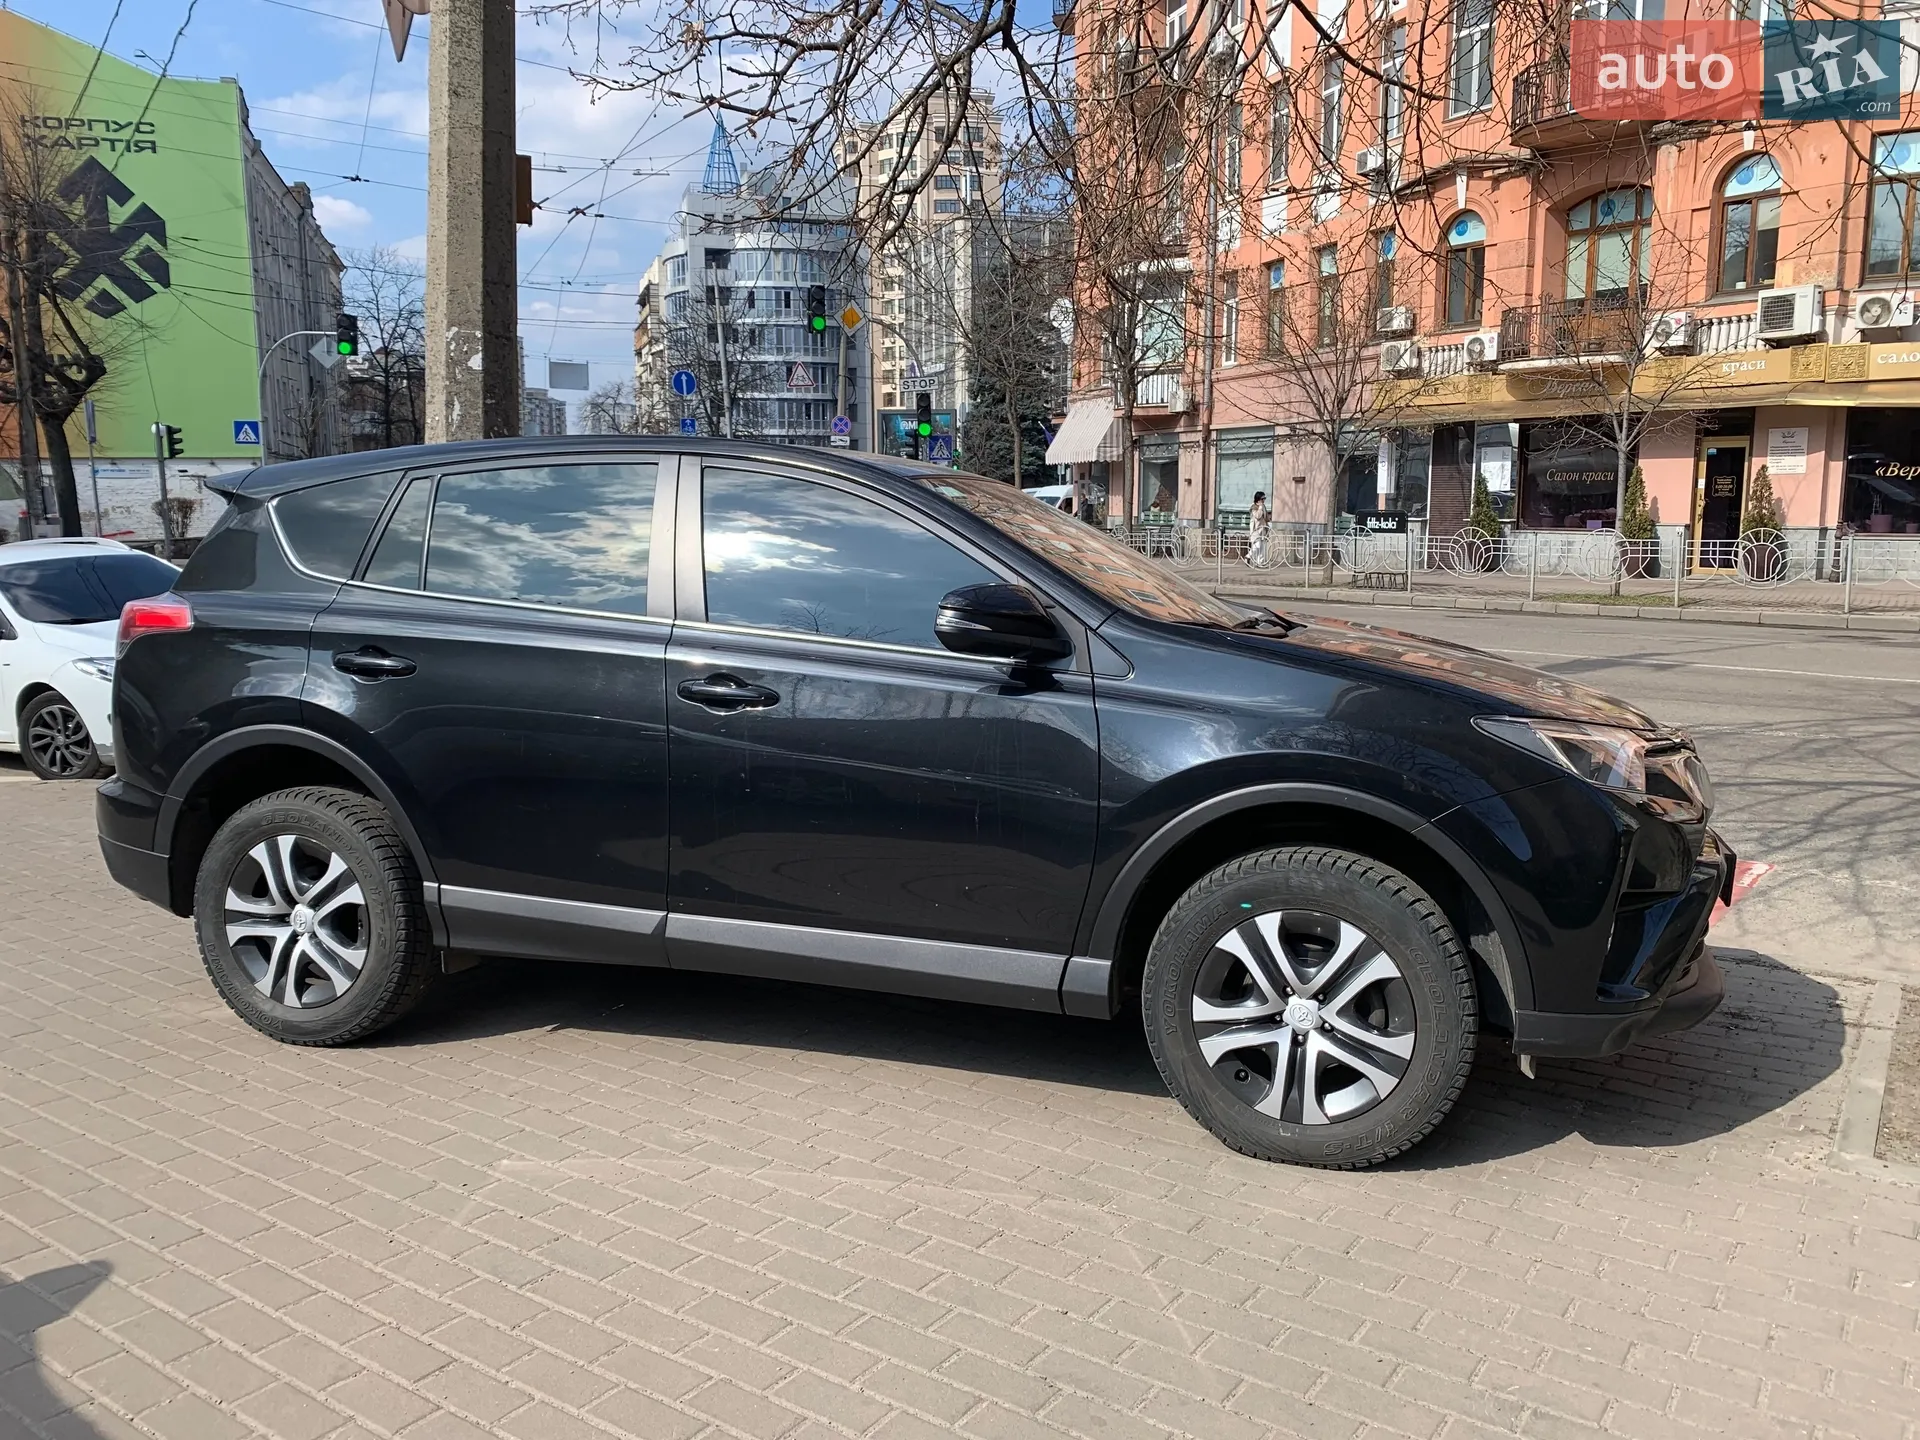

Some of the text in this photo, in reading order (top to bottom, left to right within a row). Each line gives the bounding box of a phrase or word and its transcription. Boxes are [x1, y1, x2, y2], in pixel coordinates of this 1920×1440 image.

[20, 114, 155, 135] КОРПУС
[22, 133, 157, 154] ХАРТІЯ
[1721, 359, 1766, 376] краси
[902, 379, 936, 390] STOP
[1546, 468, 1615, 484] Салон краси
[1162, 902, 1229, 1036] YOKOHAMA
[1398, 945, 1450, 1121] GEOLANDAR
